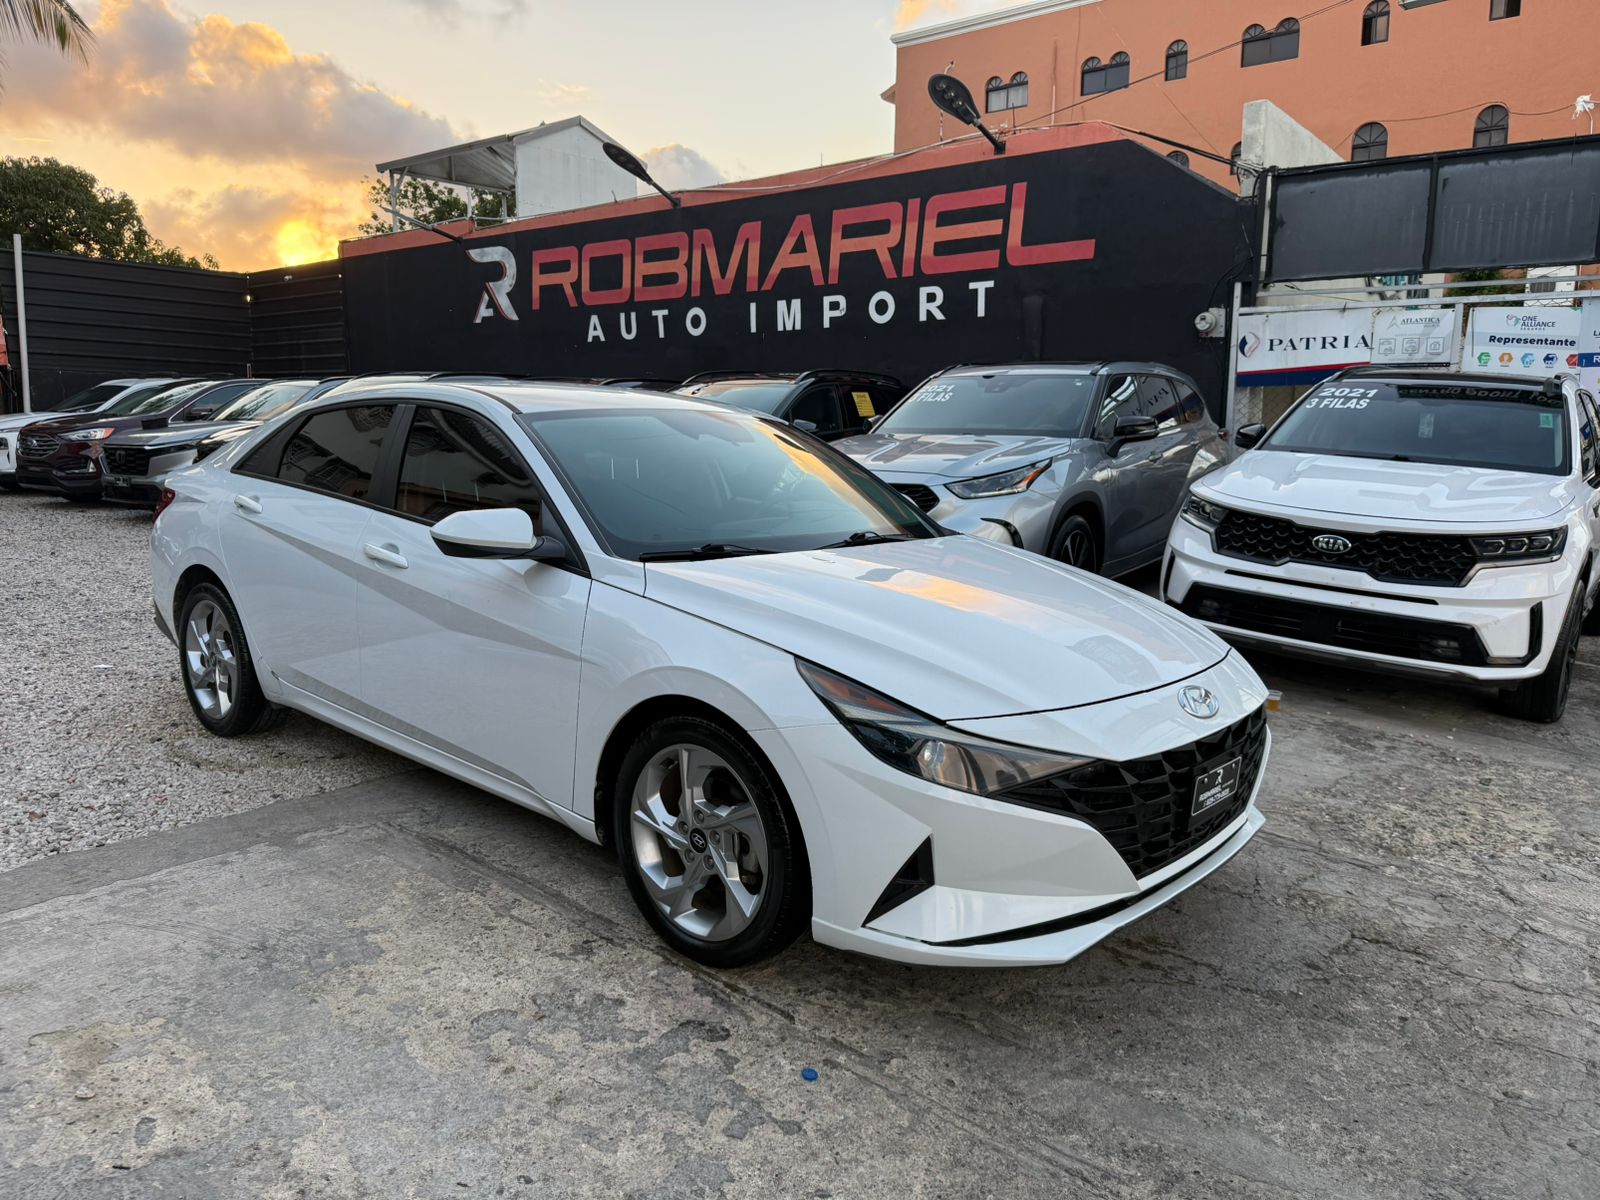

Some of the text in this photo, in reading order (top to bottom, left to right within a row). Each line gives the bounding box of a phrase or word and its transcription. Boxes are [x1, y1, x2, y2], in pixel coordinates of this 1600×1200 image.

[532, 182, 1096, 310] ROBMARIEL
[587, 280, 995, 342] AUTO IMPORT
[1400, 317, 1440, 325] ATLANTICA
[1268, 334, 1370, 351] PATRIA
[1489, 335, 1576, 347] Representante
[1319, 388, 1378, 398] 2021
[1306, 398, 1370, 409] 3 FILAS
[1319, 537, 1344, 550] KIA
